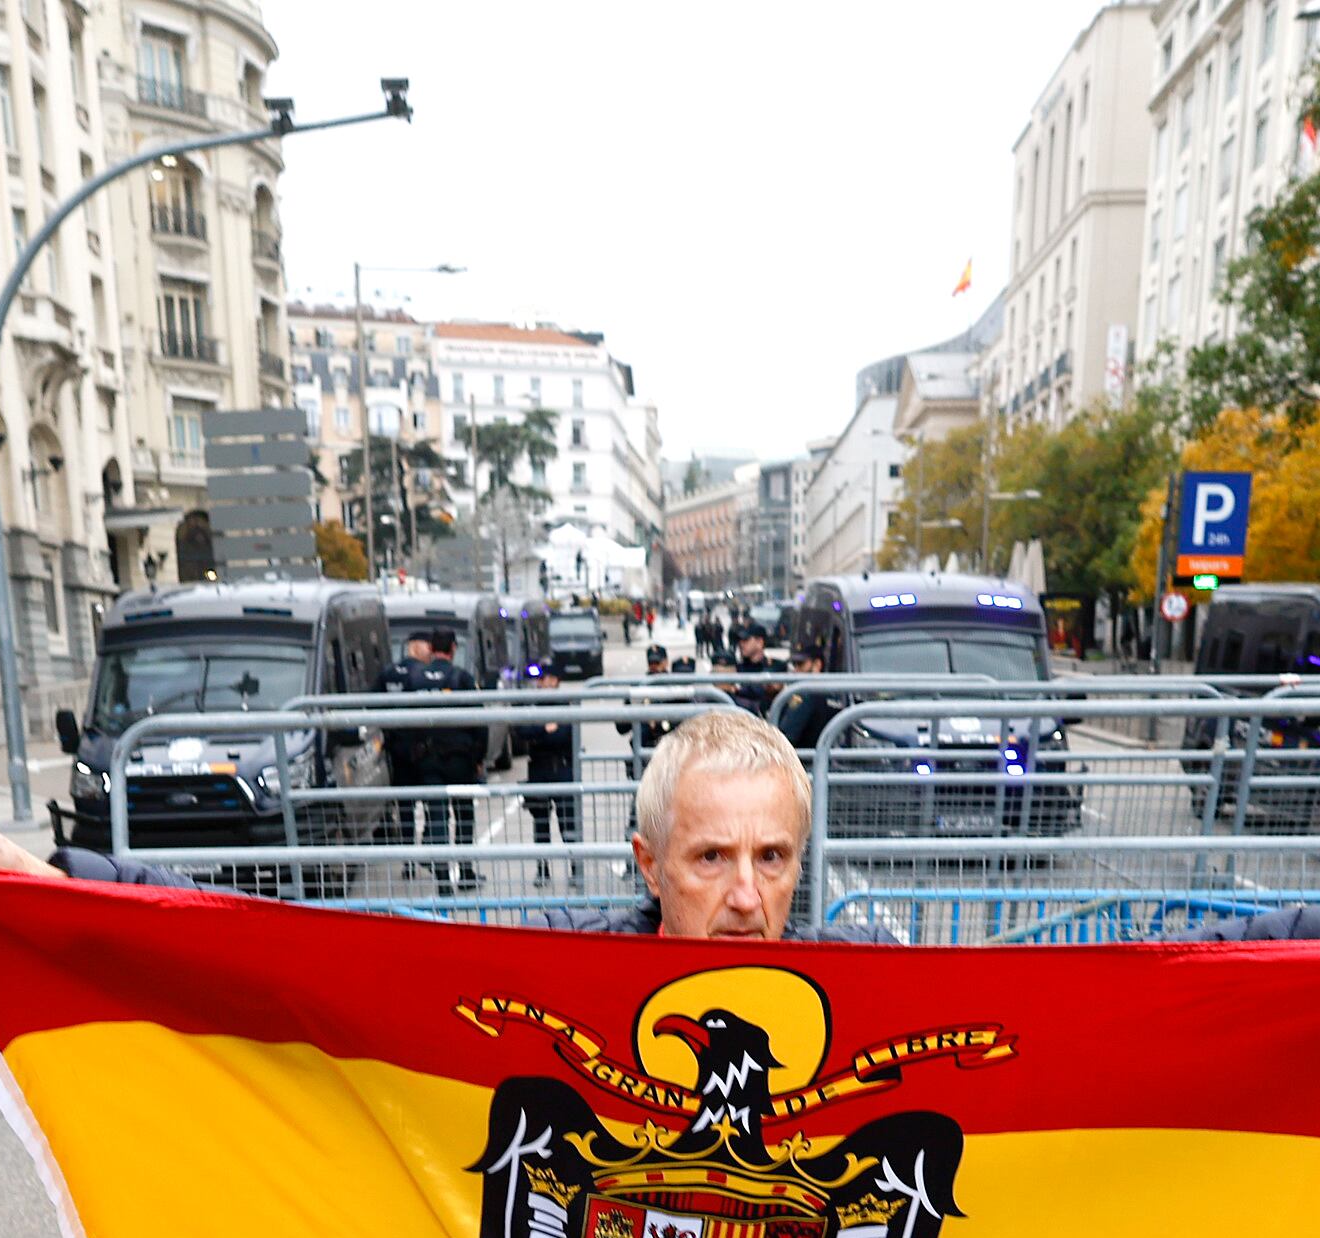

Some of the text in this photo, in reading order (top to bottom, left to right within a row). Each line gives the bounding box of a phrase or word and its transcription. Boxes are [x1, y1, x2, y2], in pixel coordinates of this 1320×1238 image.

[1191, 482, 1236, 546] P
[492, 997, 576, 1042] VNA
[592, 1063, 684, 1109] GRAN
[784, 1028, 986, 1116] DE LIBRE
